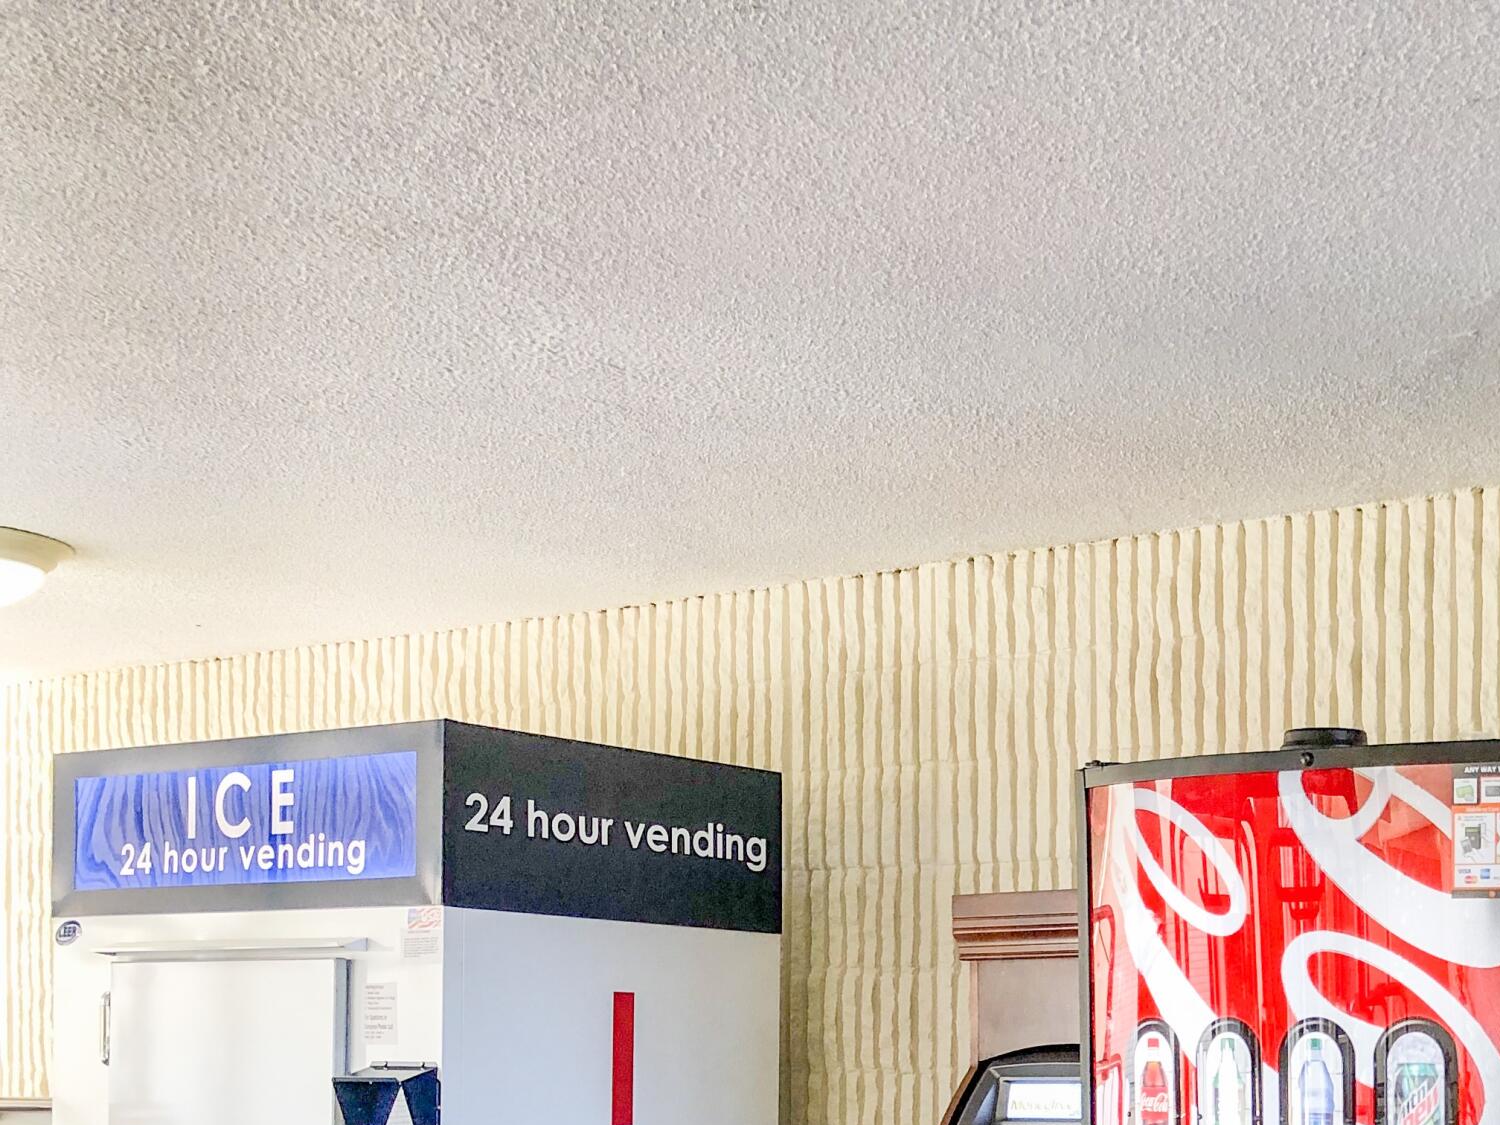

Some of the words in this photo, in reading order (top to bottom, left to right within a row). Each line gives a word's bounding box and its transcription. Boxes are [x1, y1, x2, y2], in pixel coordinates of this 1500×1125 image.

[187, 769, 294, 839] ICE
[464, 792, 514, 835] 24
[527, 799, 614, 845] hour
[624, 822, 767, 872] vending
[119, 843, 152, 876] 24
[163, 840, 228, 874] hour
[239, 833, 366, 875] vending
